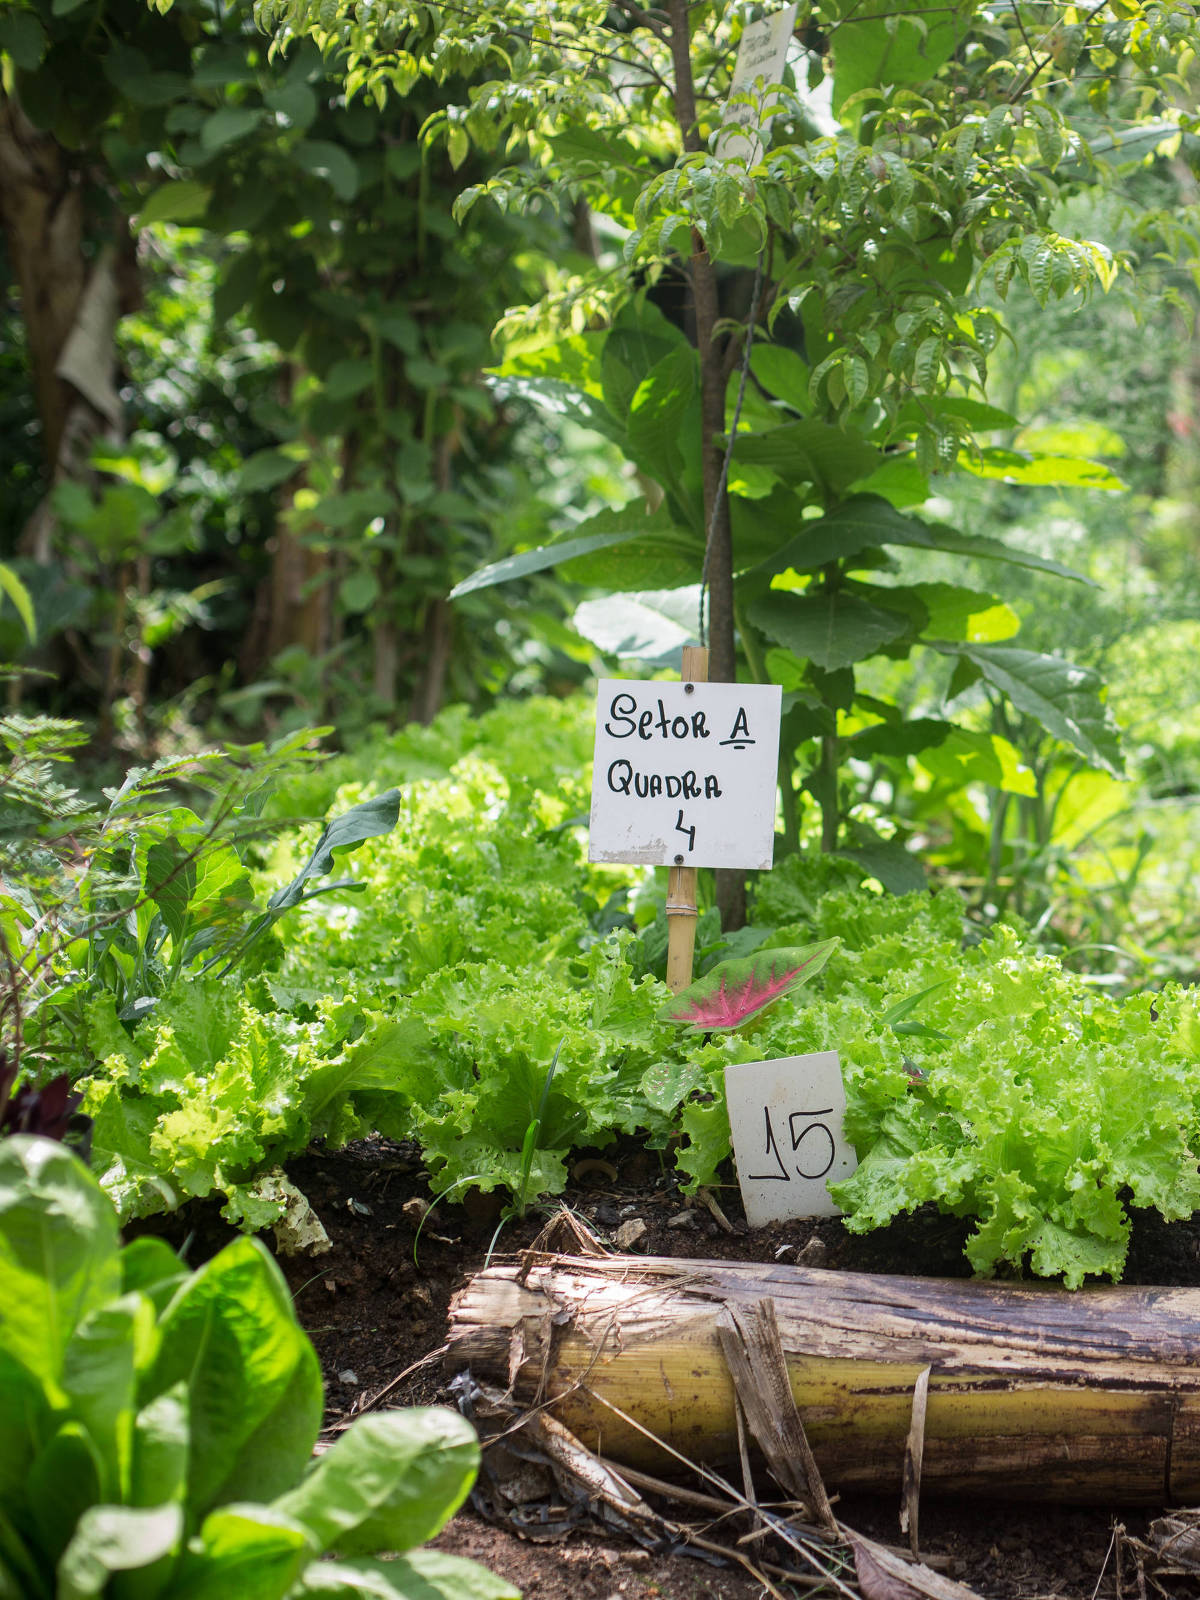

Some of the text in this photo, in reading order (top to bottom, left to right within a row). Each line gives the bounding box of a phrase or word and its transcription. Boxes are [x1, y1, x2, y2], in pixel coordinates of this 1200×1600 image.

[726, 706, 753, 744] A
[607, 758, 723, 800] QUADRA
[674, 809, 696, 852] 4
[748, 1105, 834, 1181] 15
